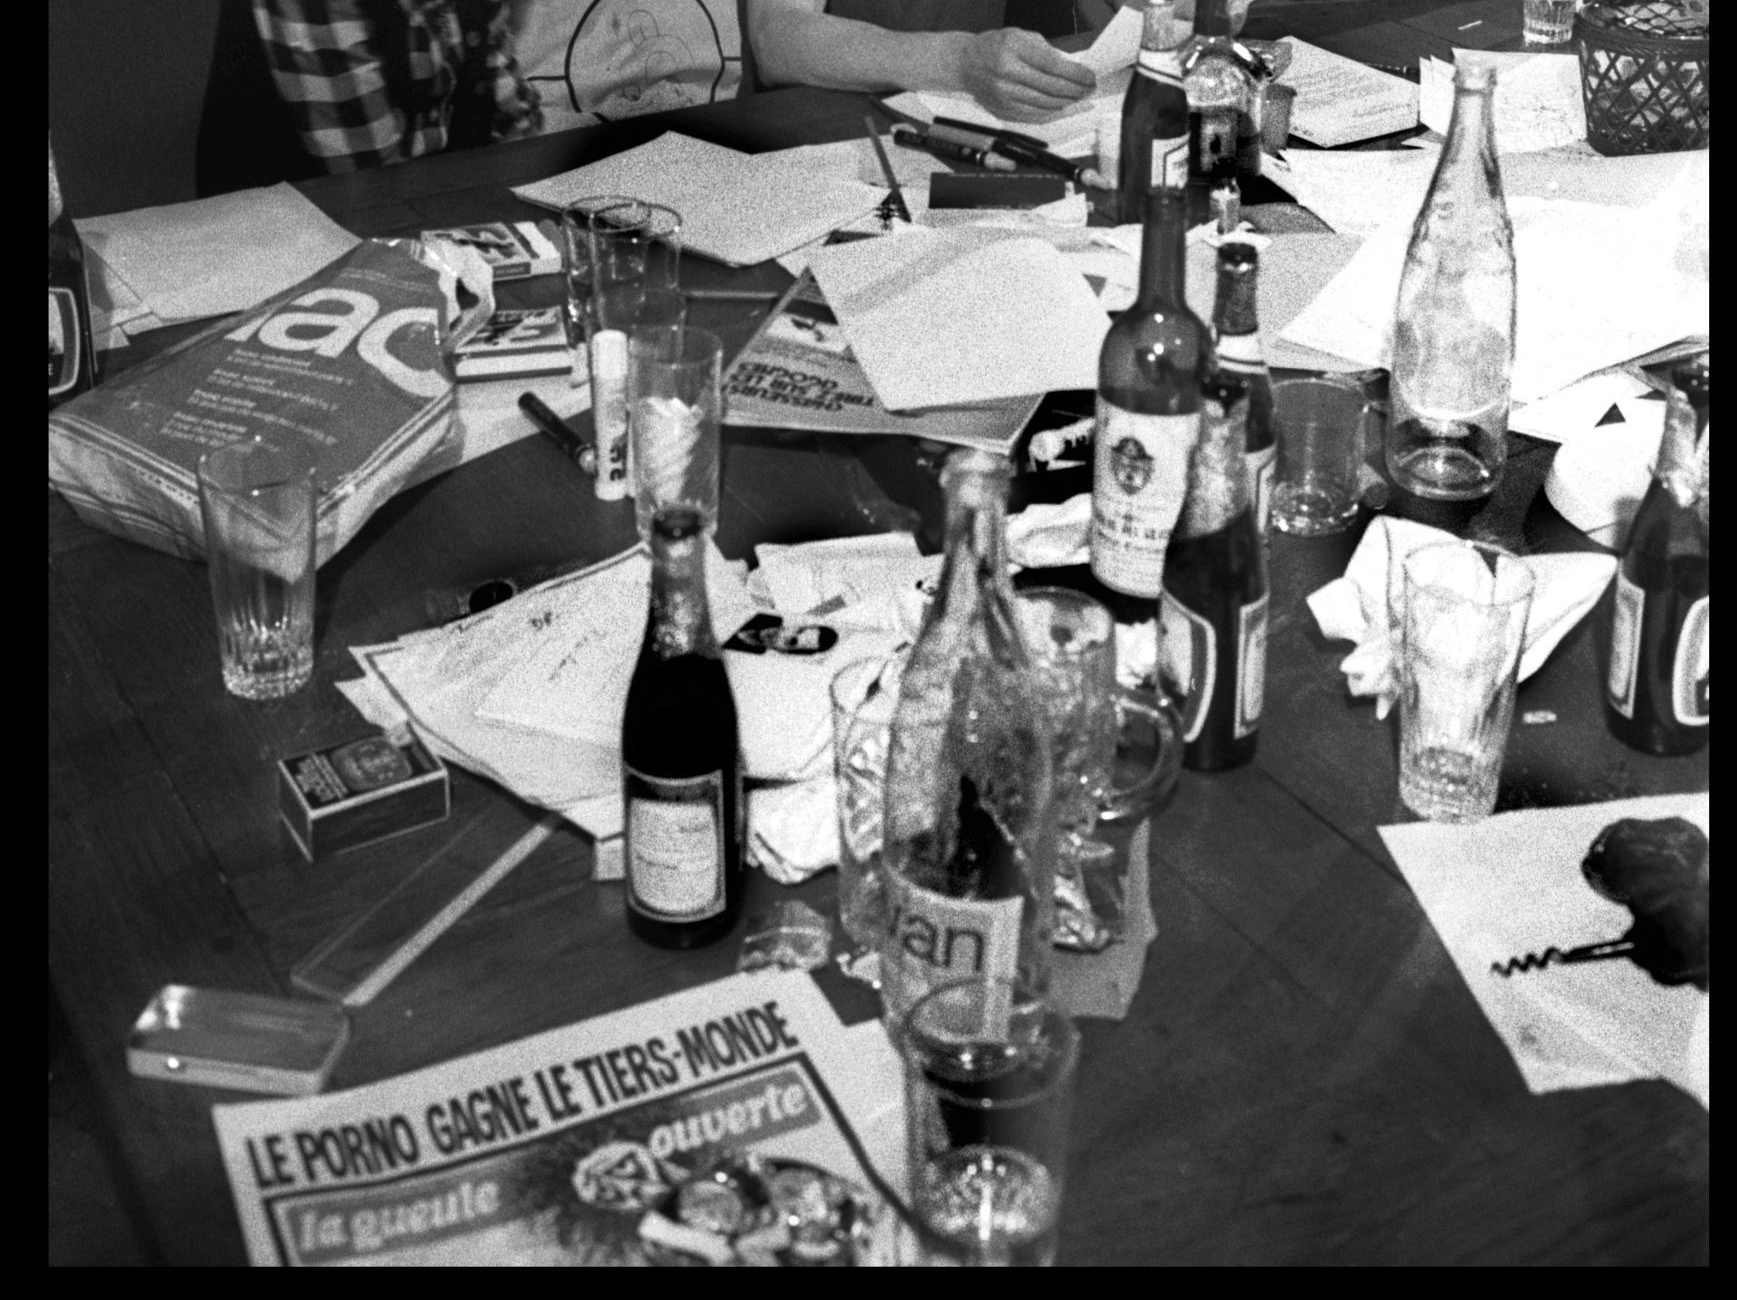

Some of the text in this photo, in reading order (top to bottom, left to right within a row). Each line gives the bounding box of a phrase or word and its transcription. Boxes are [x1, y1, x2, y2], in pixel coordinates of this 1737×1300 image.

[245, 1001, 799, 1187] LE PORNO GAGNE LE TIERS-MONDE
[650, 1083, 808, 1160] ouverte
[300, 1181, 499, 1252] la gueule
